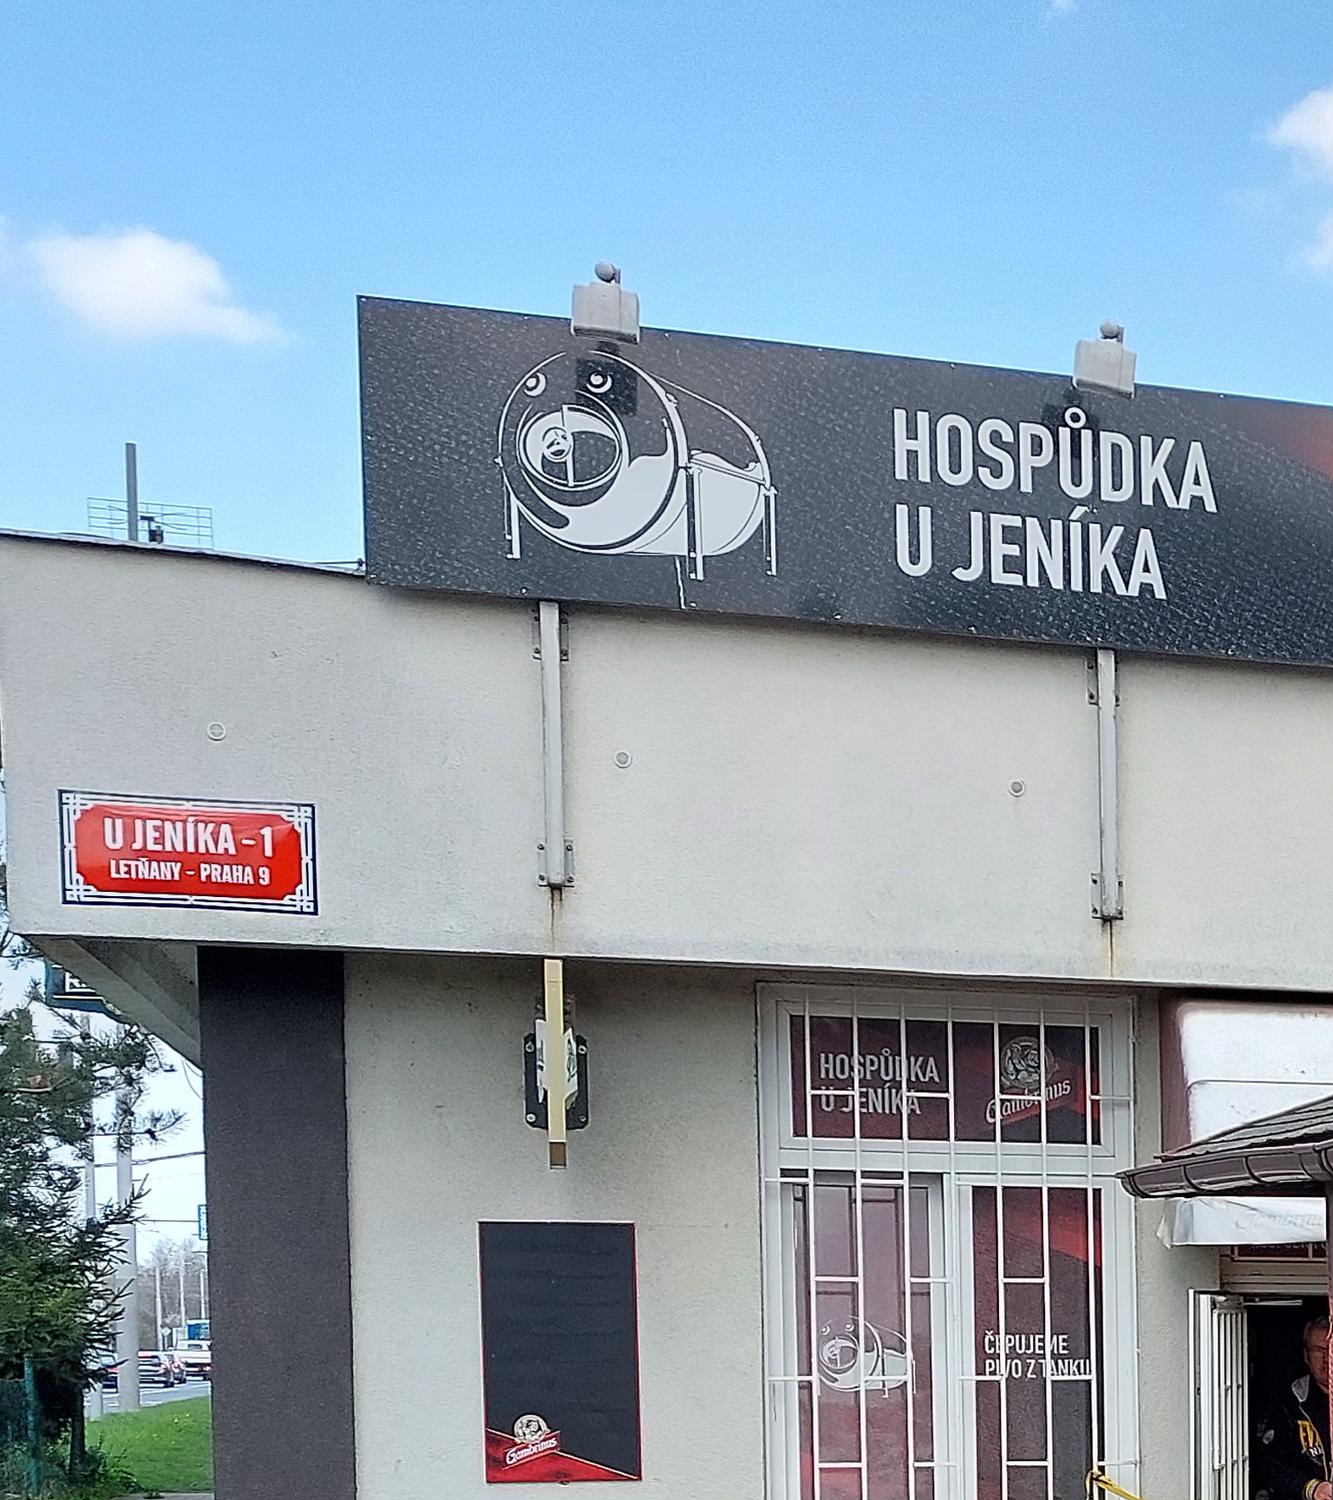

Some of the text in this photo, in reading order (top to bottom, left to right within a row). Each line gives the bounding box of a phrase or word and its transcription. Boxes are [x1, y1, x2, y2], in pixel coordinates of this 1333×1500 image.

[893, 406, 1218, 514] HOSPŮDKA
[895, 503, 1168, 600] U JENÍKA
[103, 817, 124, 850] U
[131, 816, 237, 856] JENÍKA
[259, 826, 274, 858] 1
[110, 857, 182, 882] LETŇANY
[199, 863, 254, 886] PRAHA
[258, 866, 271, 886] 9
[820, 1048, 940, 1083] HOSPŮDKA
[821, 1083, 922, 1115] U JENÍKA
[986, 1080, 1071, 1124] Gambrnus
[1026, 1359, 1037, 1378] Z
